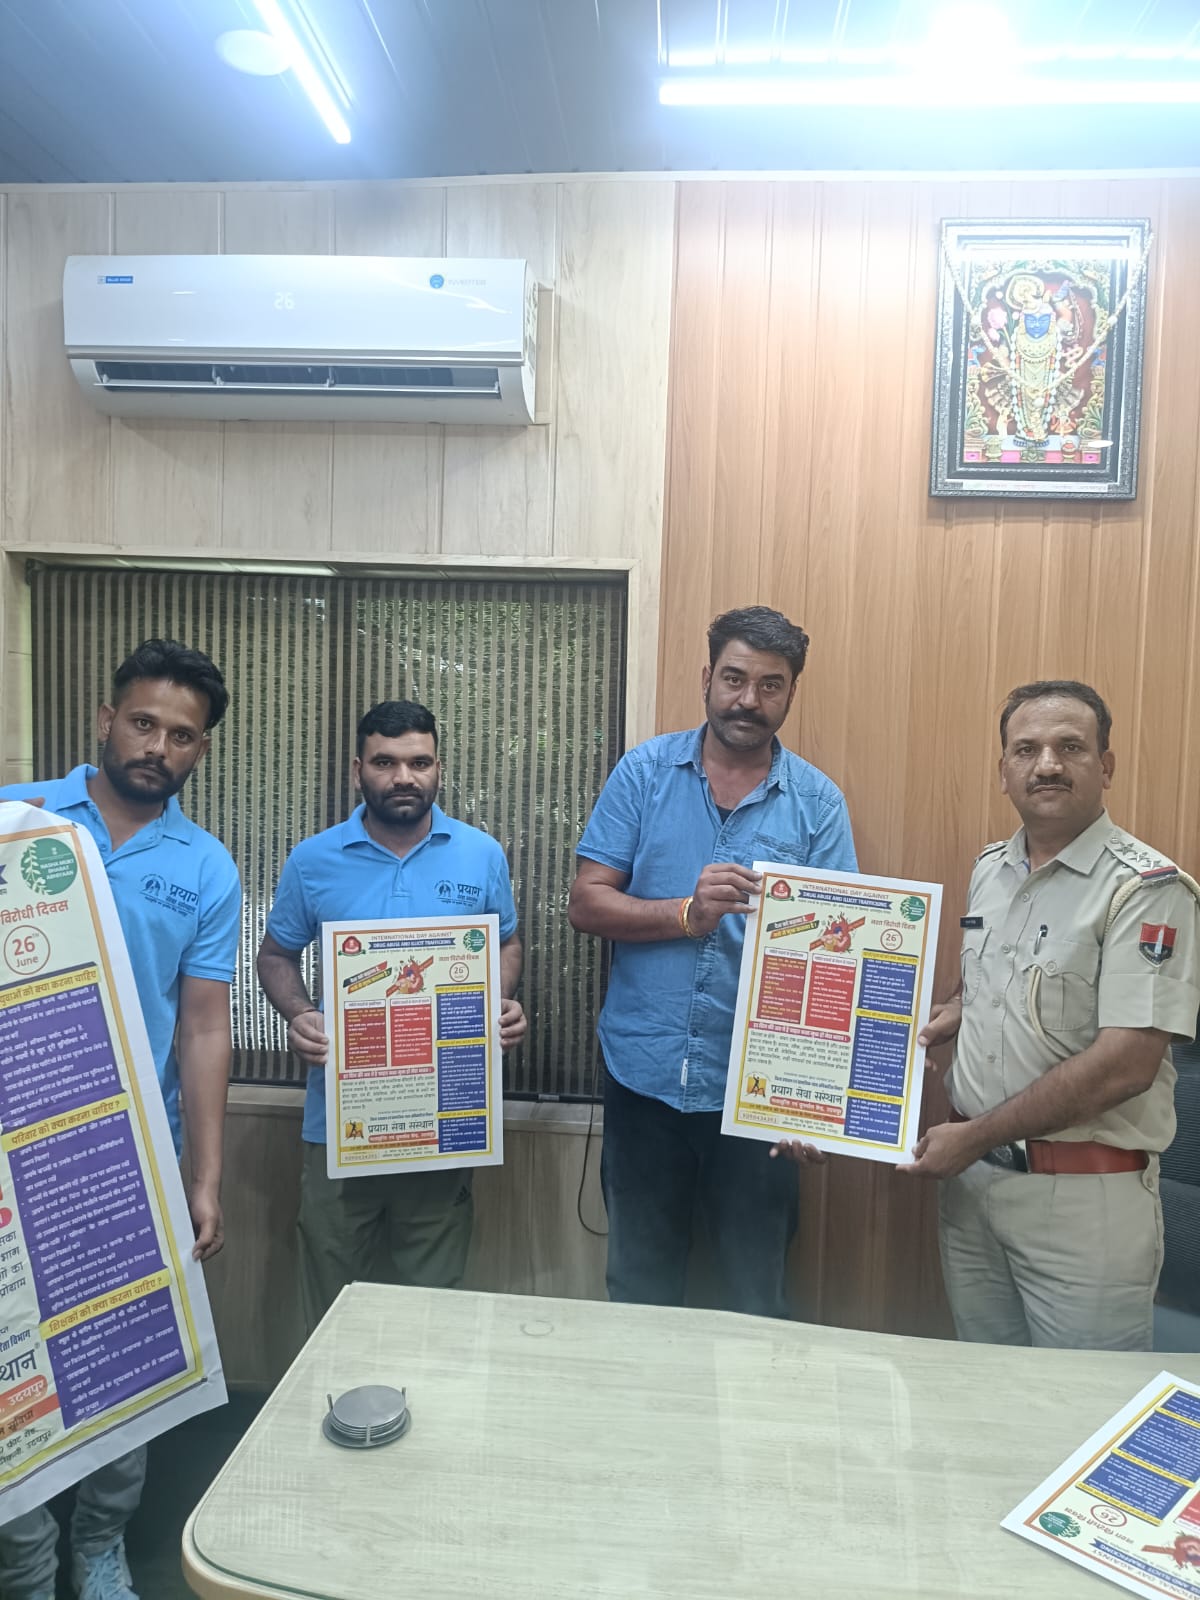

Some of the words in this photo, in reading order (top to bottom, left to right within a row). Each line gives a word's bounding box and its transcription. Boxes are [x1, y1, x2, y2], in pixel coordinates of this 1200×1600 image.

[170, 884, 199, 906] प्रयाग
[457, 883, 482, 897] प्रयाग
[36, 900, 69, 918] दिवस
[885, 932, 896, 942] 26
[16, 955, 39, 968] June
[770, 1083, 792, 1096] प्रयाग
[795, 1086, 811, 1099] सेवा
[814, 1088, 842, 1104] संस्थान
[11, 1128, 36, 1144] परिवार
[37, 1122, 49, 1134] को
[50, 1118, 66, 1129] क्या
[67, 1110, 90, 1123] करना
[368, 1123, 387, 1132] प्रयाग
[11, 1262, 24, 1274] का
[79, 1304, 91, 1317] को
[109, 1289, 132, 1304] करना
[133, 1279, 155, 1293] चाहिए
[157, 1276, 161, 1285] ?
[0, 1349, 37, 1381] थान
[8, 1380, 44, 1406] उदयपुर
[1100, 1511, 1118, 1523] 26
[1093, 1550, 1136, 1572] AGAINST
[1138, 1571, 1156, 1582] DAY
